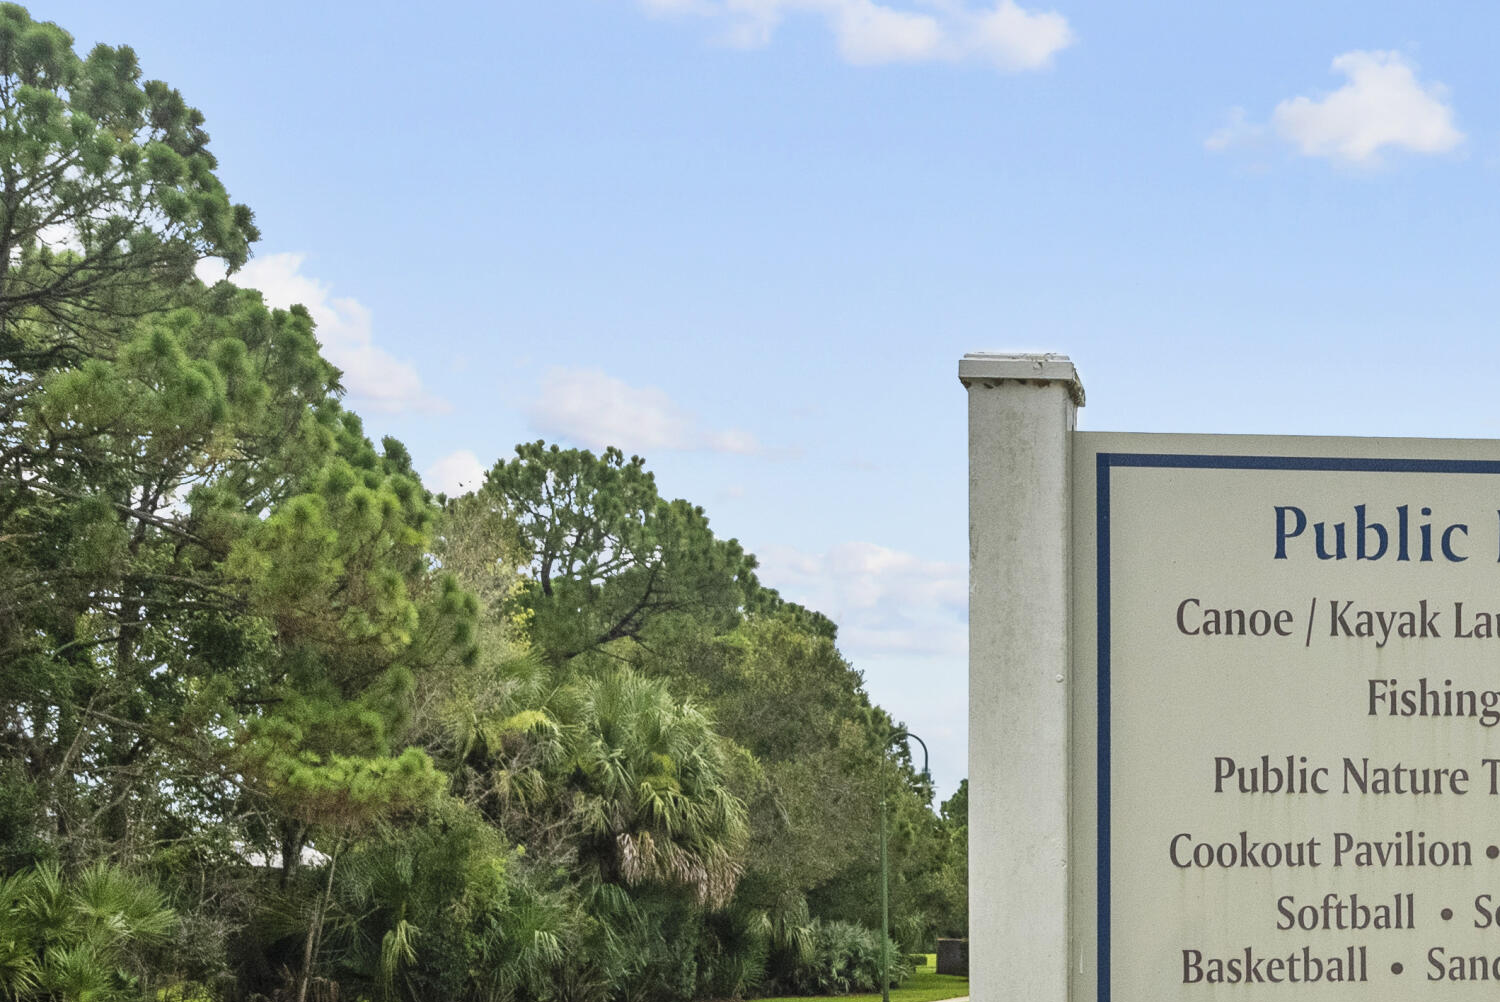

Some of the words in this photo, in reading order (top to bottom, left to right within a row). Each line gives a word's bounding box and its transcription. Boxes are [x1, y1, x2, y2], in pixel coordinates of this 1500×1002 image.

[1273, 503, 1469, 563] Public
[1176, 598, 1294, 637] Canoe
[1329, 599, 1441, 649] Kayak
[1214, 754, 1329, 795] Public
[1342, 757, 1470, 796] Nature
[1169, 830, 1322, 870] Cookout
[1333, 830, 1473, 868] Pavilion
[1276, 892, 1416, 931] Softball
[1181, 945, 1368, 985] Basketball
